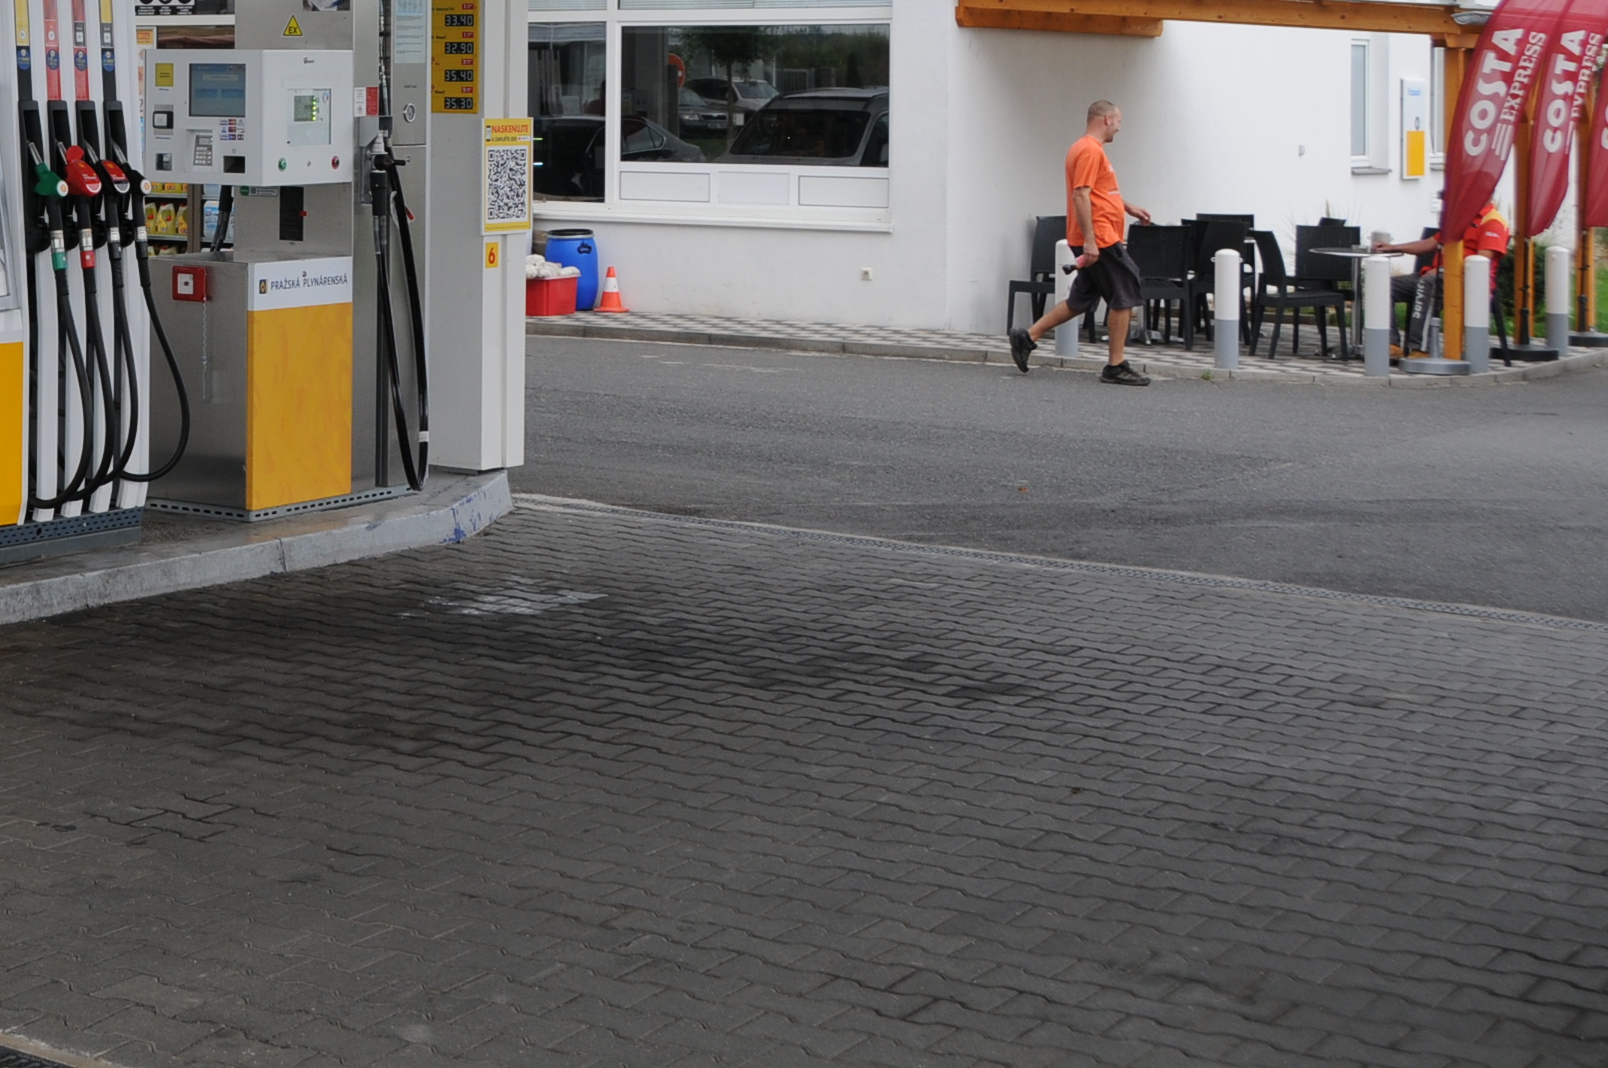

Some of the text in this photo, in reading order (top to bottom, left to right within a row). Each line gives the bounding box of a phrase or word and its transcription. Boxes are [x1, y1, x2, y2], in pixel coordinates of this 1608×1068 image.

[446, 15, 473, 26] 33.40
[446, 43, 473, 53] 32.90
[445, 70, 473, 81] 35.40
[1500, 31, 1546, 122] EXPRESS
[1464, 28, 1524, 156] COSTA
[1543, 30, 1586, 153] COSTA
[445, 98, 472, 109] 35.30
[492, 124, 528, 133] NASKENUJTE
[488, 247, 496, 264] 6
[271, 273, 348, 291] PRAŽSKÁ PLYNÁRENSKÁ
